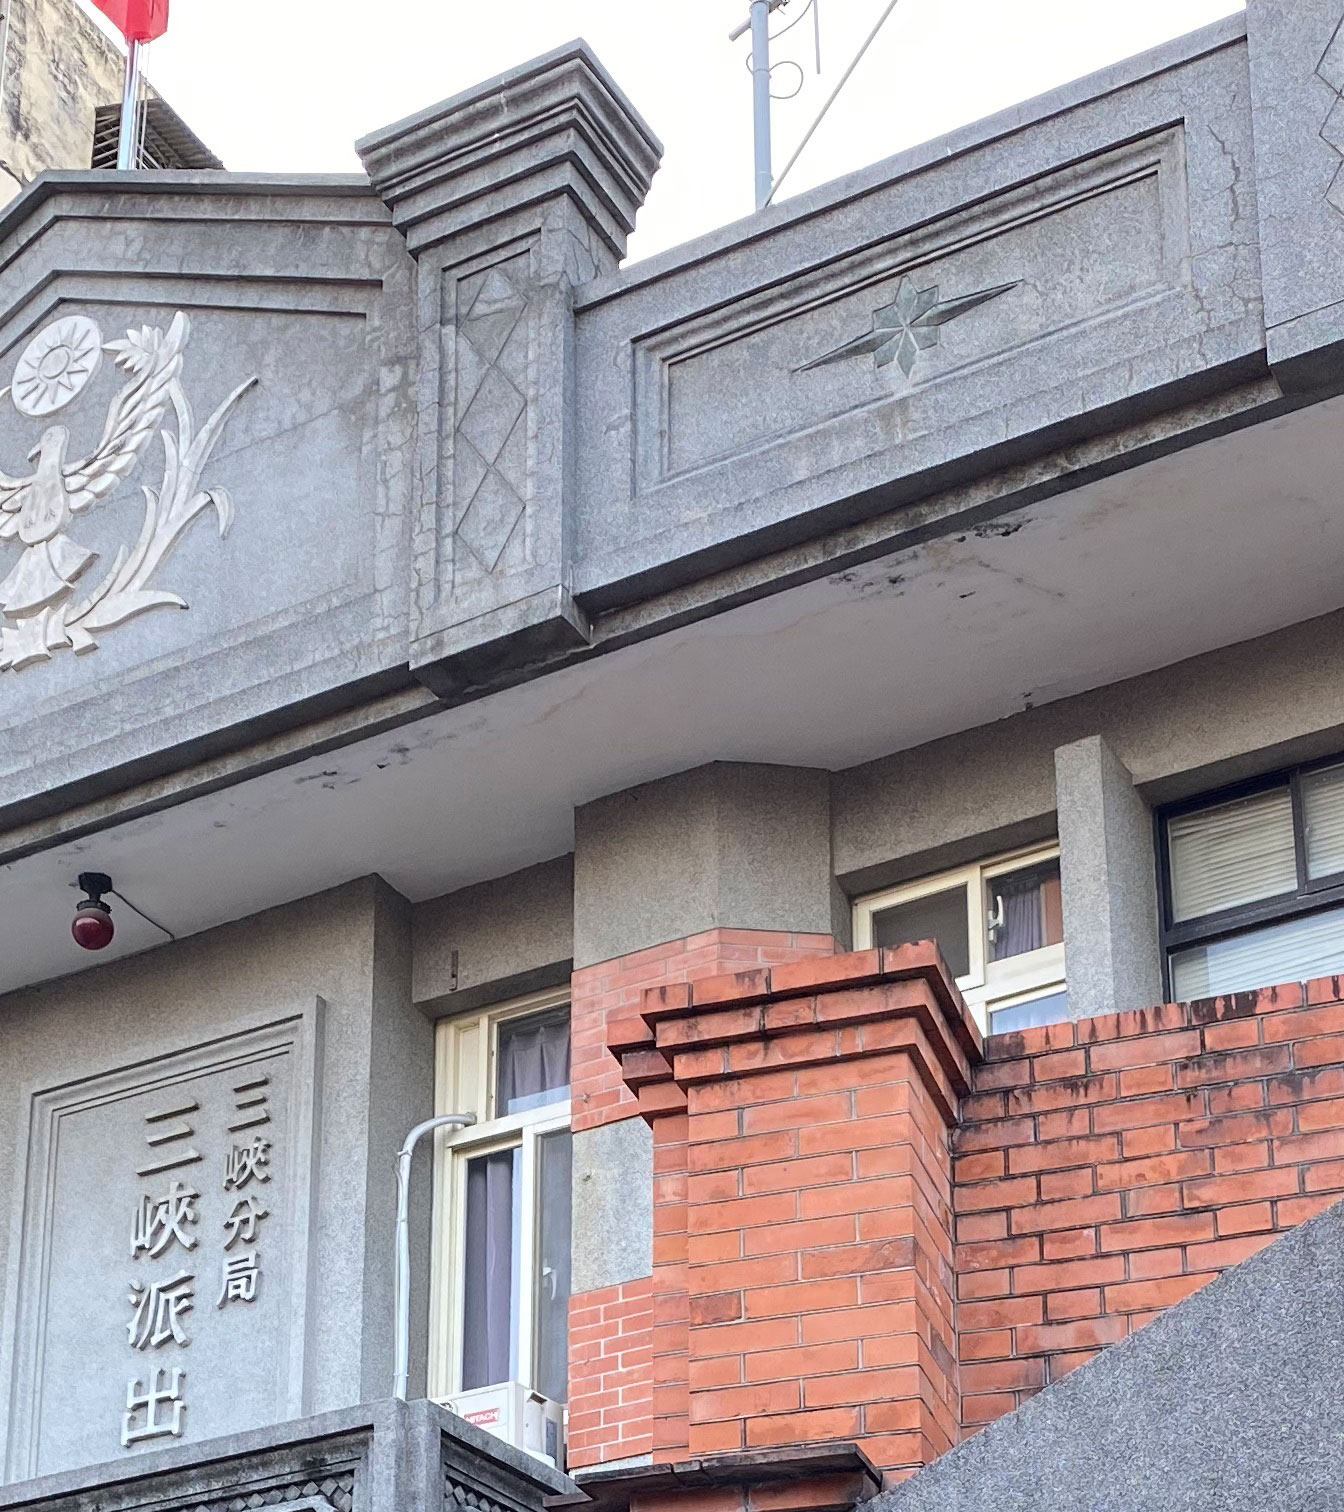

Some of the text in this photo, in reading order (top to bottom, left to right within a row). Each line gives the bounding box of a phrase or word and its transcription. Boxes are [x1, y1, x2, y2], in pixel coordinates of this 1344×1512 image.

[120, 1100, 203, 1448] 三峽派出
[216, 1072, 273, 1309] 三峽分局
